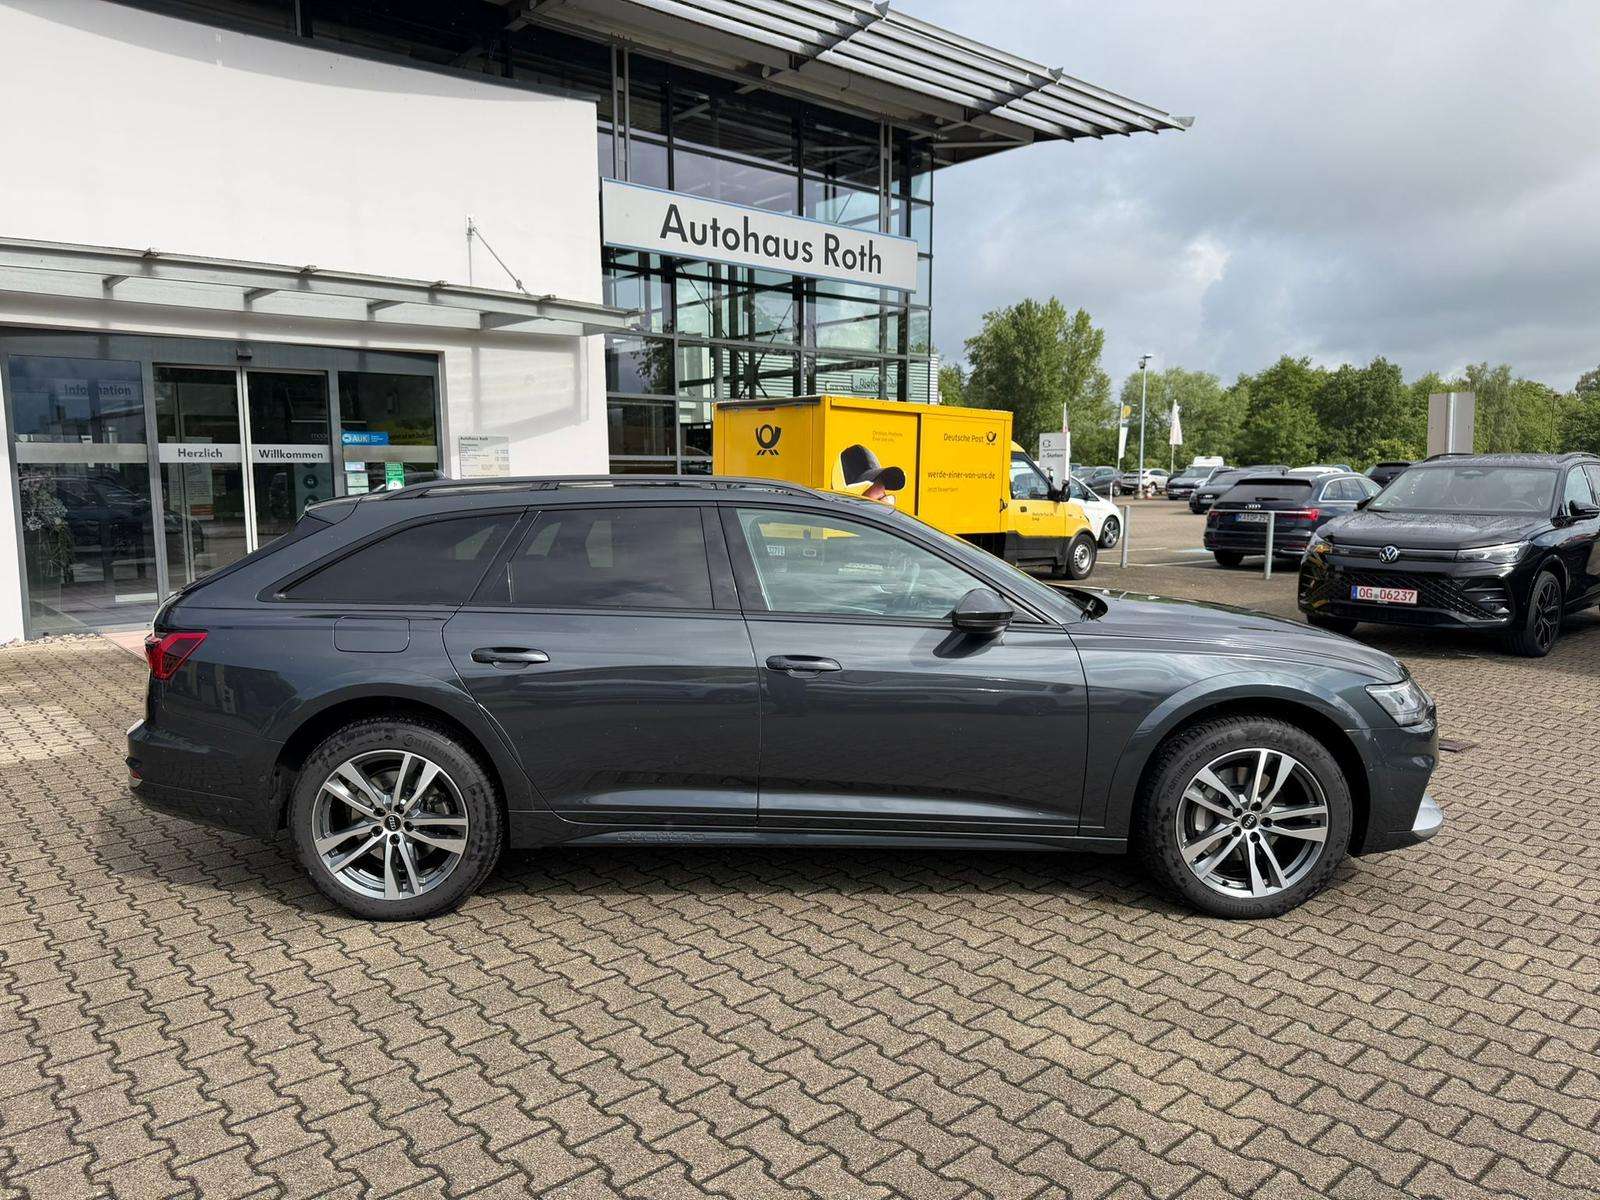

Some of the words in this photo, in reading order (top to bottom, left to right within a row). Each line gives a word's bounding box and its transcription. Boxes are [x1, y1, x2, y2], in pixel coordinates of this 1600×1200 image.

[660, 203, 813, 263] Autohaus
[824, 232, 882, 274] Roth
[64, 383, 132, 396] Infomation
[943, 432, 970, 443] Deutsche
[971, 434, 984, 443] Post
[177, 447, 223, 458] Herzlich
[258, 448, 324, 460] Willkommen
[927, 470, 996, 480] werde-einer-von-uns.de
[1359, 587, 1373, 598] OG
[1379, 589, 1415, 602] 06237
